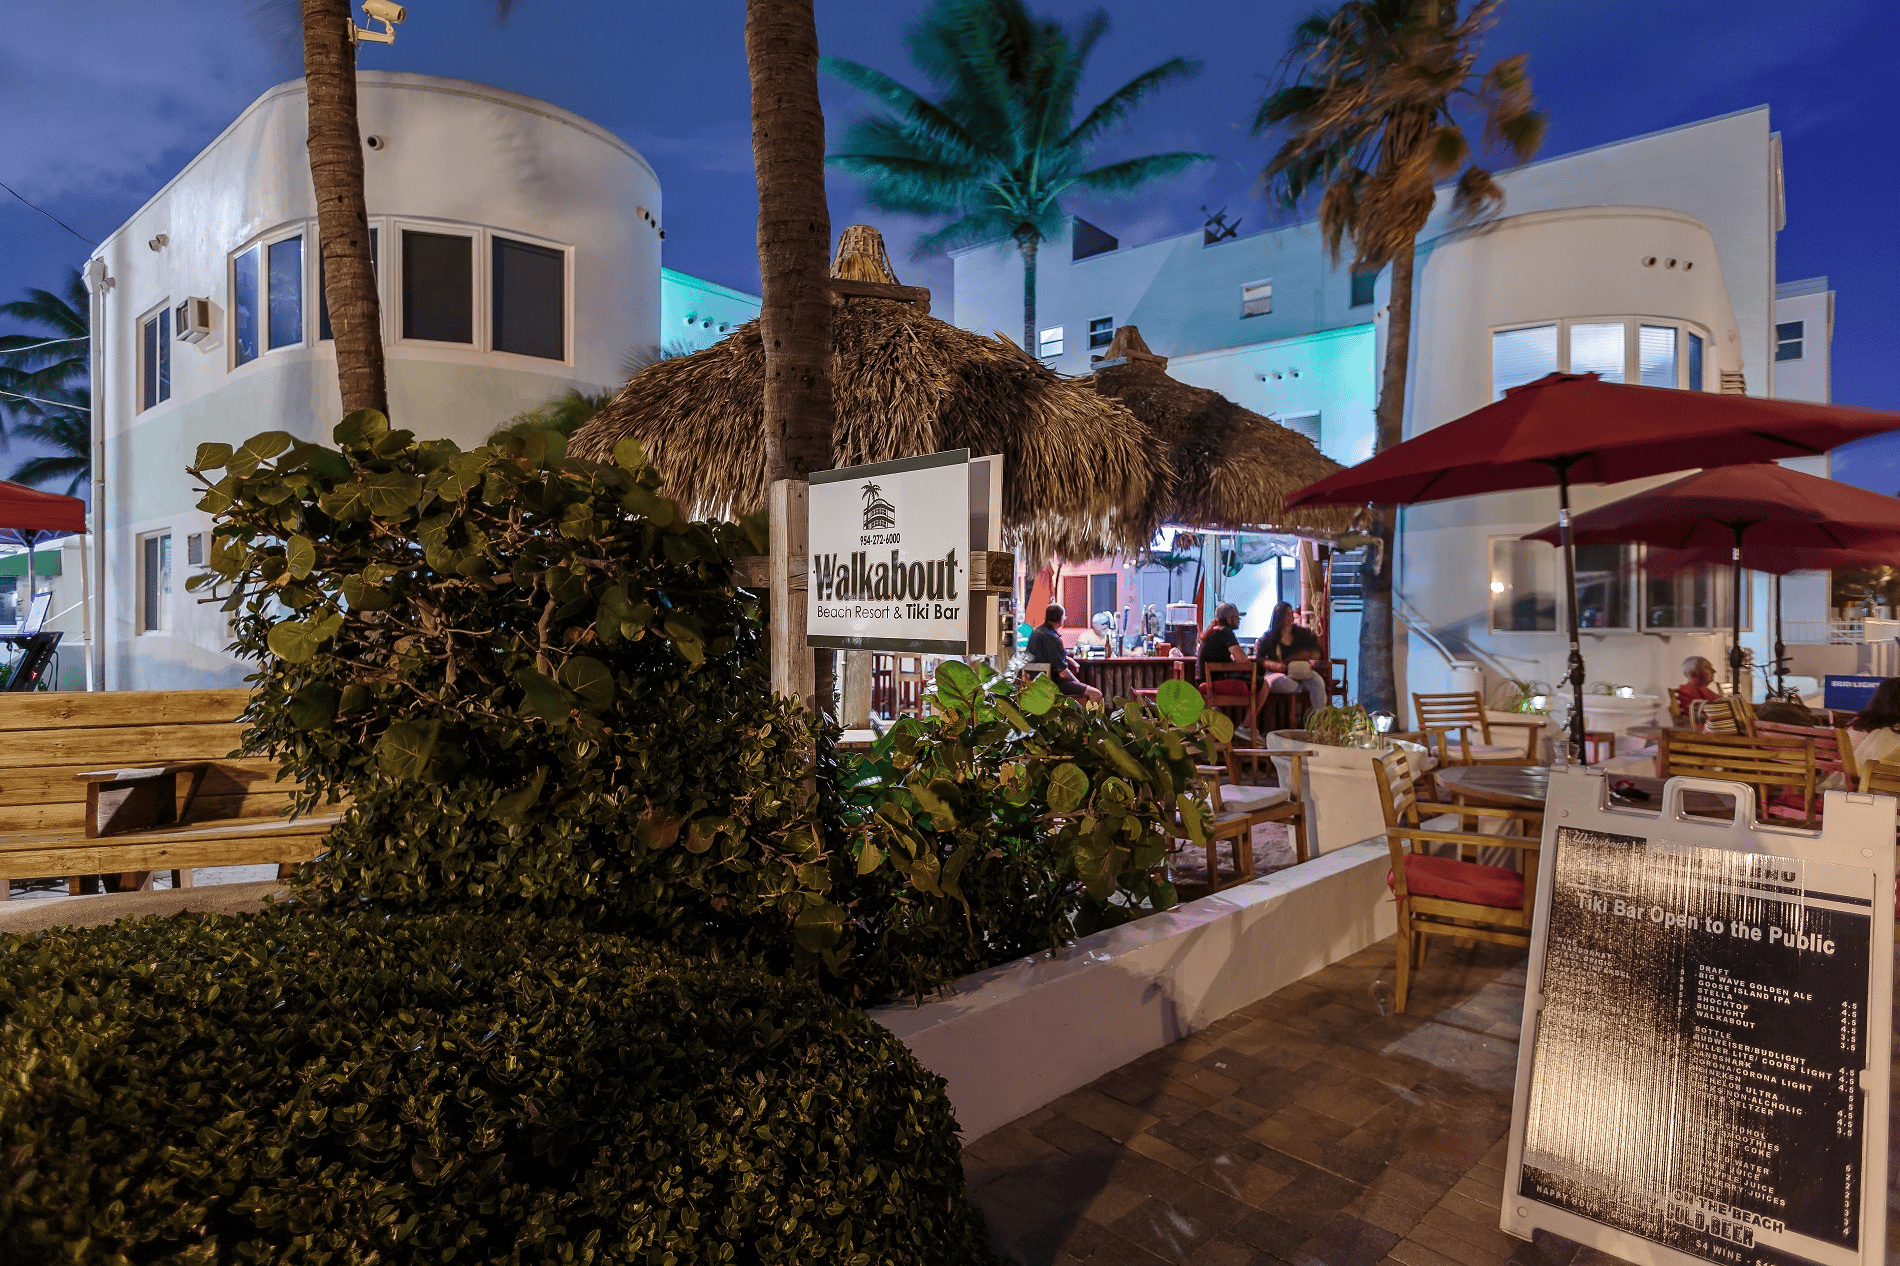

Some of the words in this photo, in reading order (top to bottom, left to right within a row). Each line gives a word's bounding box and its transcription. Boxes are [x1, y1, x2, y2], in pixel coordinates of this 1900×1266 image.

[860, 533, 900, 546] 954-272-6000
[814, 548, 958, 601] Walkabout
[817, 605, 852, 618] Beach
[855, 605, 890, 619] Resort
[894, 606, 902, 619] &
[906, 603, 930, 620] Tiki
[934, 603, 960, 620] Bar
[1740, 866, 1796, 883] ENU
[1577, 893, 1608, 914] Tiki
[1614, 898, 1646, 921] Bar
[1651, 905, 1698, 930] Open
[1705, 916, 1724, 935] to
[1731, 920, 1762, 942] the
[1769, 926, 1836, 955] Public
[1699, 964, 1729, 976] DRAFT
[1697, 987, 1733, 1000] STELLA
[1841, 1017, 1857, 1026] 4.5
[1698, 972, 1715, 981] BIG
[1719, 976, 1745, 987] WAVE
[1749, 982, 1789, 996] GOLDEN
[1793, 992, 1813, 1001] ALE
[1842, 1001, 1857, 1010] 4.5
[1698, 980, 1730, 992] GOOSE
[1734, 988, 1769, 1000] ISLAND
[1774, 995, 1791, 1005] IPA
[1841, 1009, 1857, 1018] 4.5
[1695, 1025, 1732, 1039] BOTTLE
[1696, 995, 1749, 1011] SHOCKTOP
[1840, 1026, 1856, 1035] 4.5
[1696, 1002, 1745, 1019] BUDLIGHT
[1840, 1034, 1856, 1043] 3.5
[1696, 1010, 1756, 1029] WALKABOUT
[1840, 1042, 1856, 1051] 3.5
[1692, 1041, 1728, 1055] MILLER
[1732, 1051, 1758, 1062] LITE/
[1762, 1057, 1796, 1072] COORS
[1801, 1067, 1833, 1080] LIGHT
[1839, 1076, 1855, 1085] 4.5
[1693, 1033, 1807, 1065] BUDWEISER/BUDLIGHT
[1839, 1067, 1855, 1077] 4.5
[1693, 1049, 1752, 1069] LANDSHARK
[1838, 1084, 1854, 1093] 4.5
[1693, 1056, 1777, 1084] CORONA/CORONA
[1781, 1078, 1813, 1093] LIGHT
[1727, 1090, 1803, 1116] NON-ALCHOLIC
[1837, 1119, 1853, 1128] 4.5
[1729, 1099, 1774, 1117] SELTZER
[1836, 1127, 1852, 1137] 3.5
[1745, 1086, 1779, 1101] ULTRA
[1837, 1110, 1853, 1120] 4.5
[1848, 1103, 1854, 1111] 5
[1734, 1159, 1770, 1175] WATER
[1844, 1191, 1850, 1199] 2
[1744, 1145, 1772, 1158] COKE
[1845, 1173, 1851, 1181] 2
[1744, 1179, 1774, 1194] JUICE
[1844, 1209, 1849, 1217] 3
[1748, 1189, 1787, 1207] JUICES
[1844, 1200, 1850, 1208] 3
[1845, 1182, 1851, 1190] 2
[1536, 1184, 1568, 1205] HAPPY
[1713, 1244, 1743, 1262] WINE
[1698, 1196, 1729, 1216] THE
[1731, 1206, 1785, 1234] BEACH
[1709, 1214, 1755, 1249] BEER
